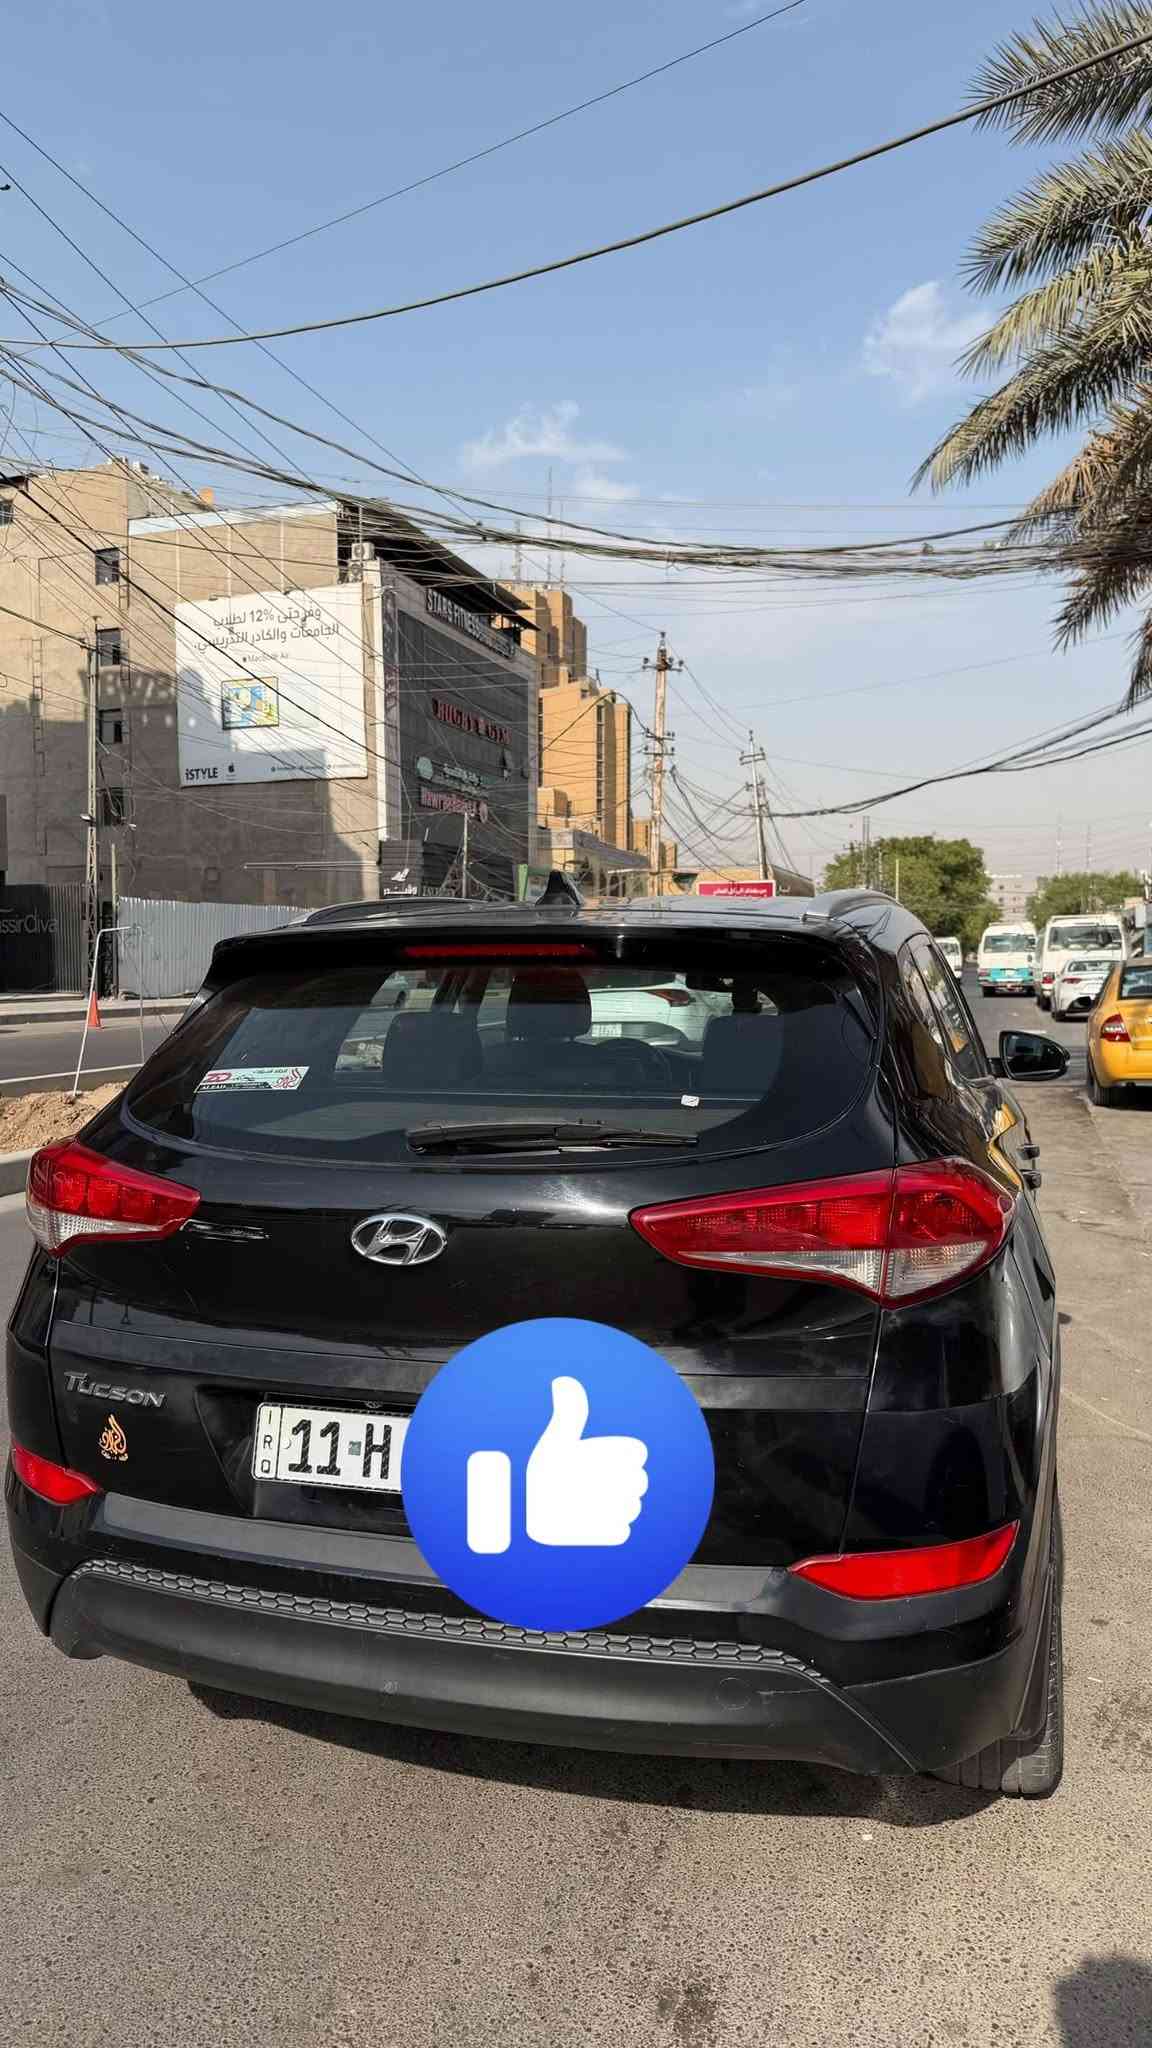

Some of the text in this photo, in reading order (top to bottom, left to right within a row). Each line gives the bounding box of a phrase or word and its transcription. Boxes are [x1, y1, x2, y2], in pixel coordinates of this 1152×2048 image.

[250, 608, 275, 623] 12%
[278, 606, 300, 624] حتى
[251, 628, 287, 644] والكادر
[185, 767, 219, 781] iSTYLE
[63, 1371, 166, 1408] TUCSON
[287, 1418, 393, 1480] 11 H
